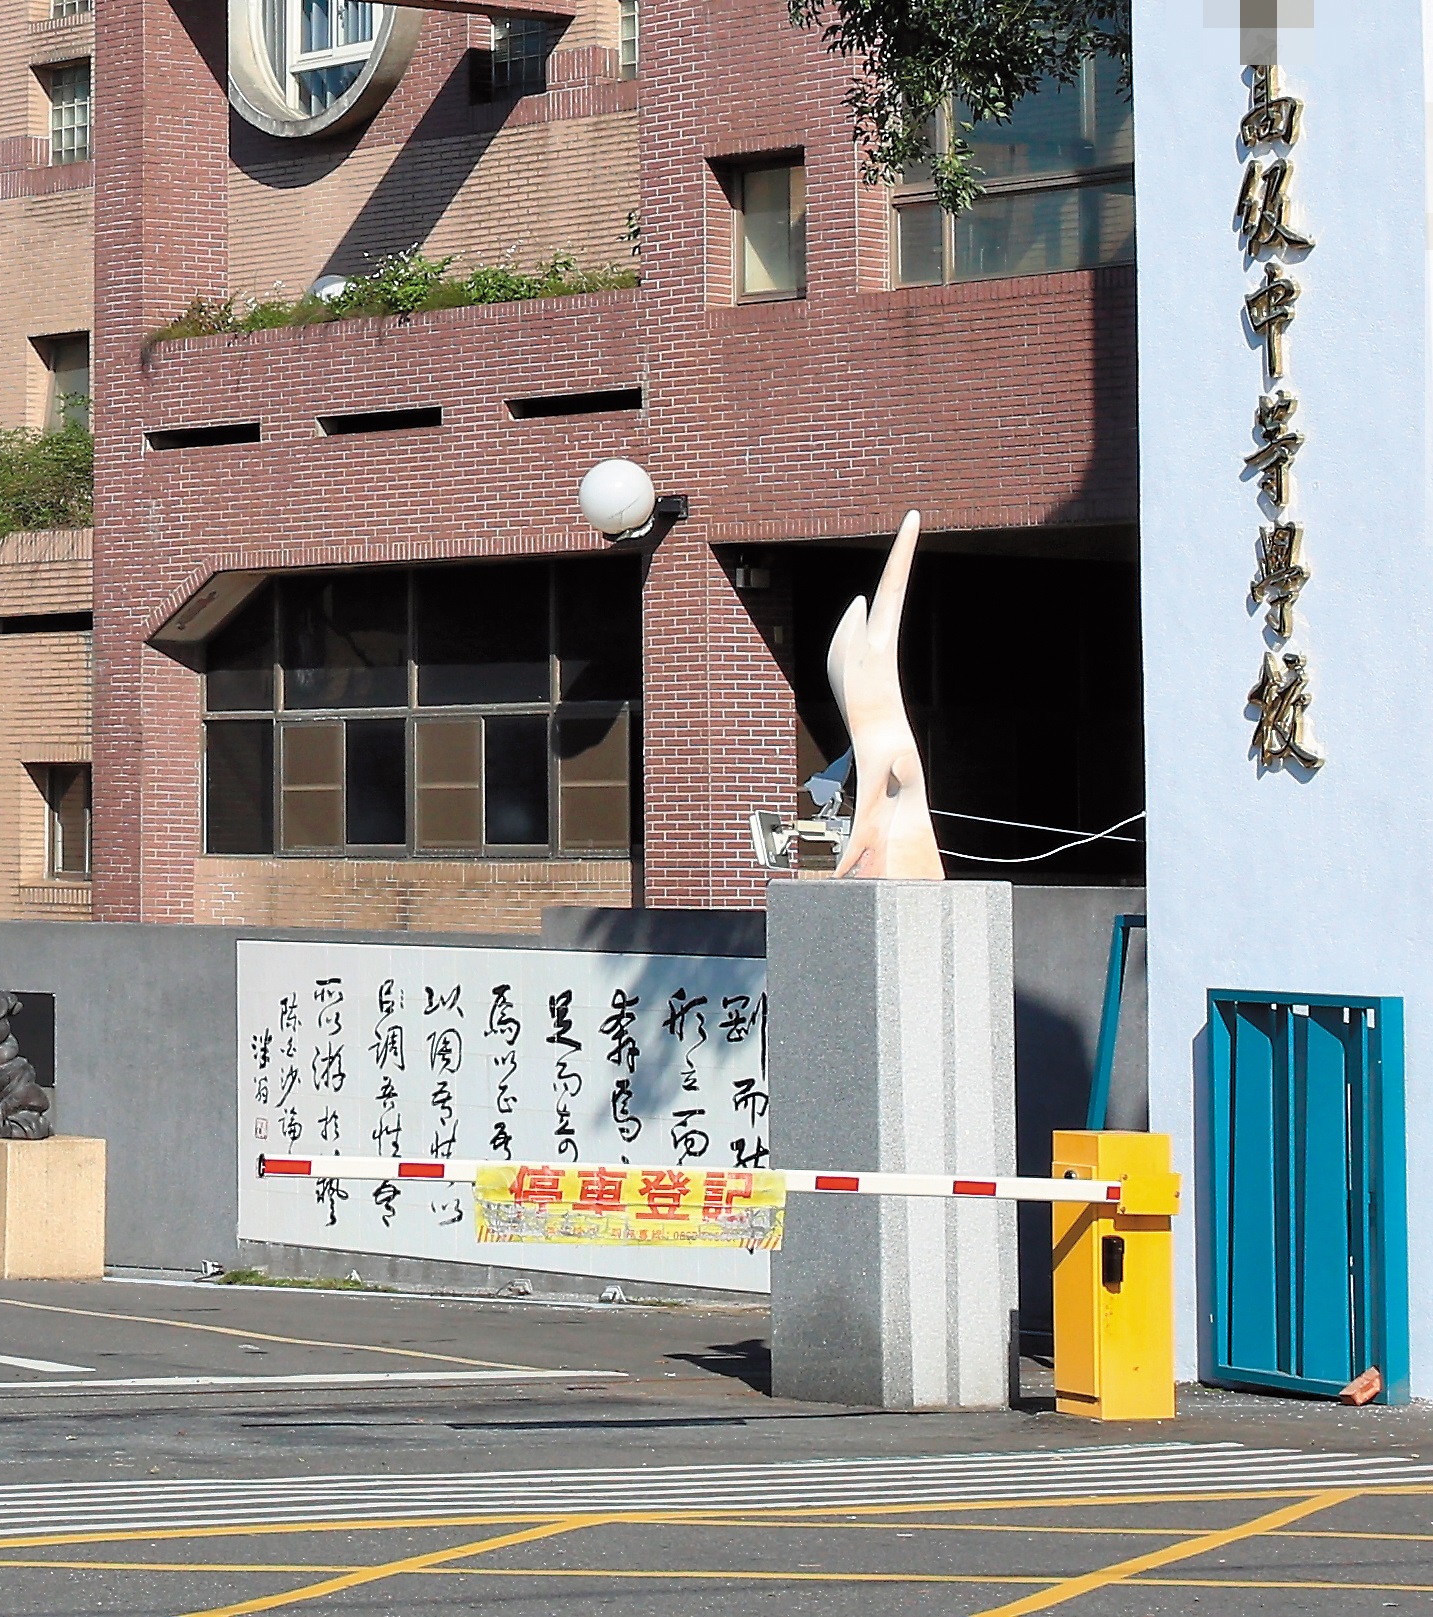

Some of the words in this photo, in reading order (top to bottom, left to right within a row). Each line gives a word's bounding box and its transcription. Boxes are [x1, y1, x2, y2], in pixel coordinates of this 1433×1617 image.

[483, 985, 521, 1162] 焉以正吾
[598, 988, 642, 1166] 奔焉
[662, 988, 710, 1166] 形立而
[719, 990, 769, 1168] 剛而能
[508, 1165, 754, 1223] 停車登記
